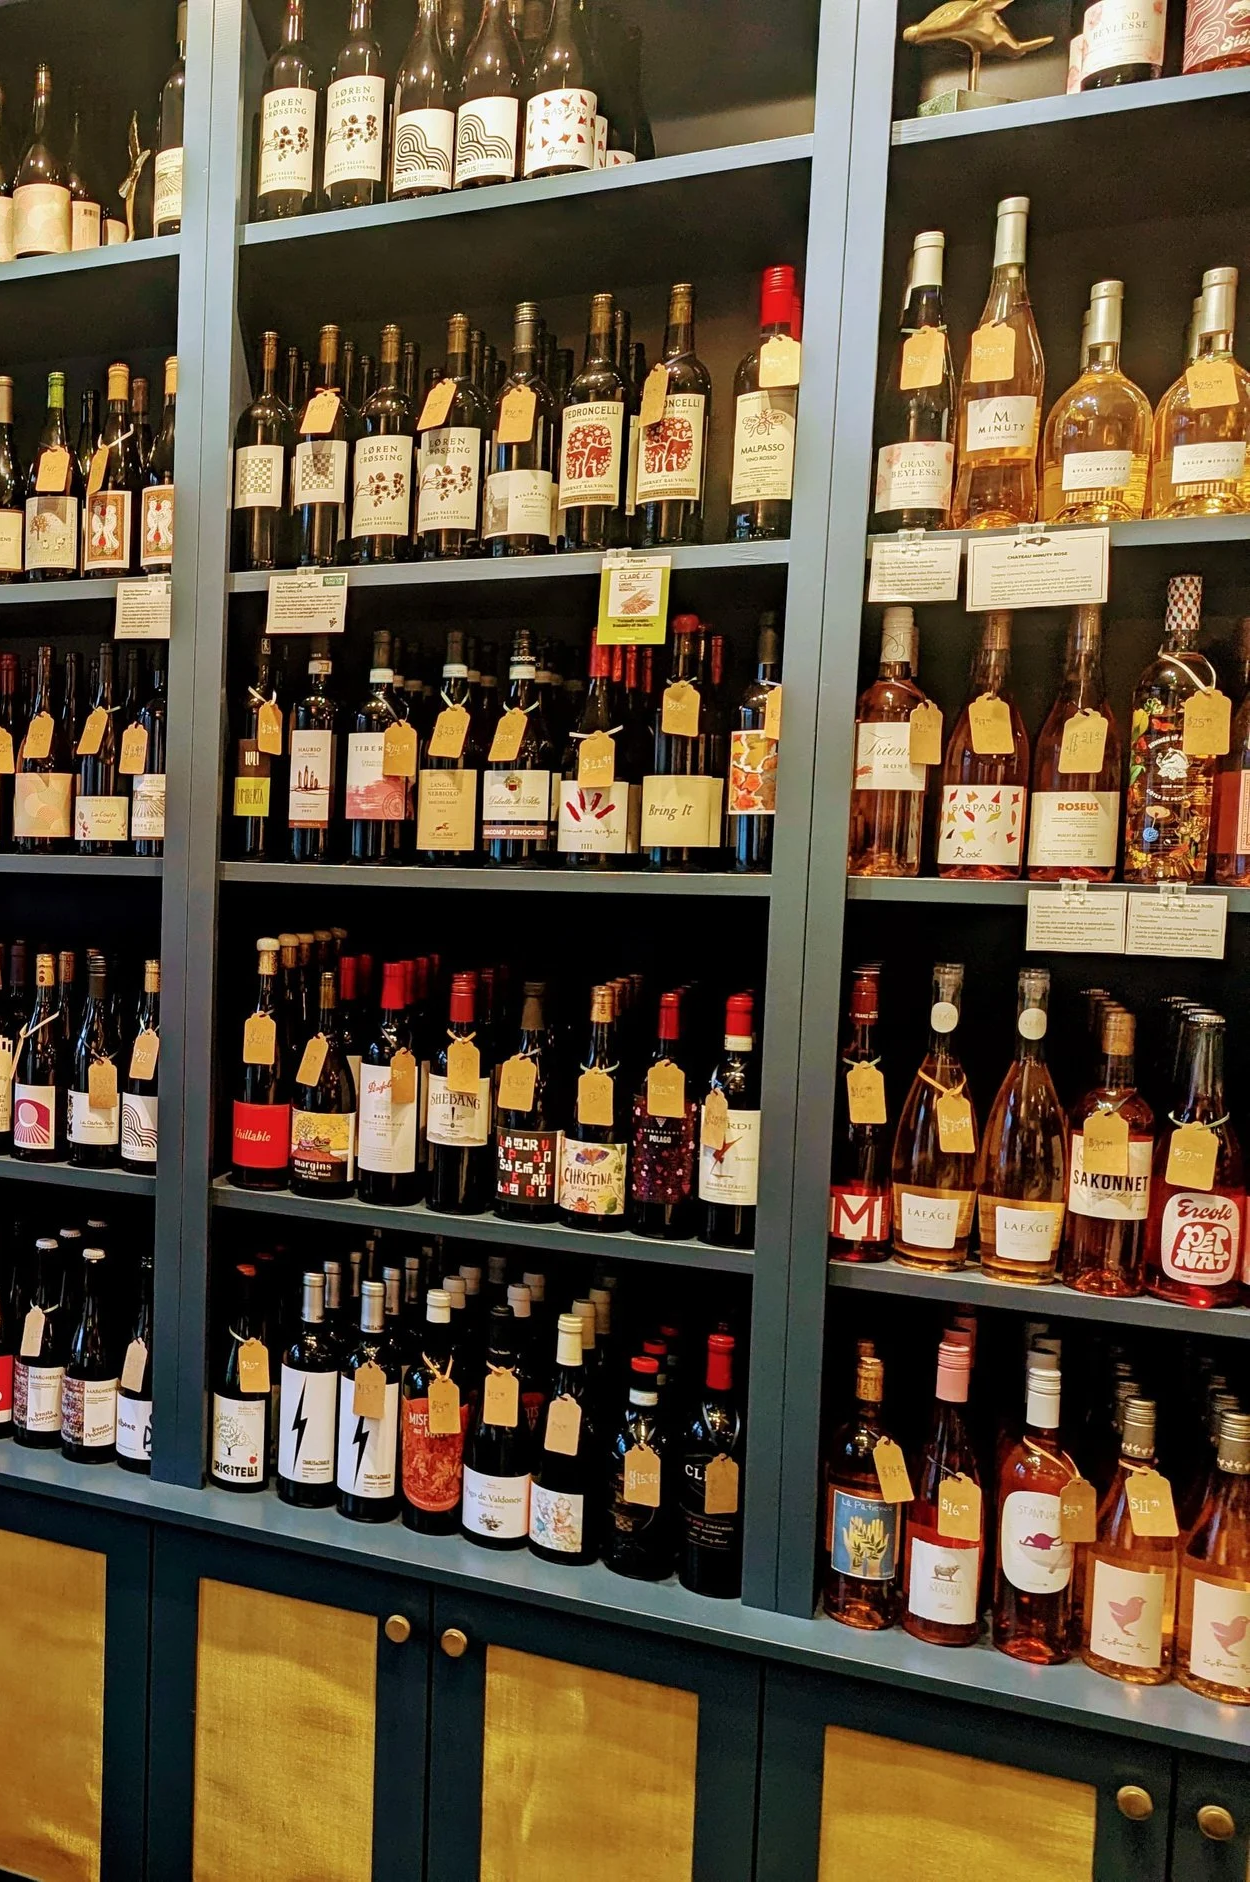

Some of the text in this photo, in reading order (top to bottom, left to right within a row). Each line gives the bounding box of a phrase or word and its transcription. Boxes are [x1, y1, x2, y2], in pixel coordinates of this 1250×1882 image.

[663, 399, 700, 409] ONCELLI
[565, 405, 619, 419] PEDRONCELLI
[978, 423, 1025, 434] MINUTY
[363, 445, 398, 455] LØREN
[740, 443, 785, 455] MALPASSO
[359, 454, 403, 464] CRØSSING
[900, 460, 935, 469] GRAND
[891, 469, 942, 478] BEYLESSE
[951, 803, 1001, 813] GASPARD
[1057, 802, 1100, 811] ROSEUS
[648, 804, 694, 821] Bring It
[953, 846, 983, 858] Rosé
[430, 1092, 481, 1110] SHEBANG
[727, 1122, 752, 1131] RDI
[648, 1134, 672, 1143] POLAGO
[294, 1159, 332, 1171] margins
[563, 1167, 613, 1186] CHRISTINA
[1073, 1169, 1149, 1192] SAKONNET
[1177, 1198, 1234, 1221] Ercole
[1173, 1249, 1230, 1270] NAT
[408, 1411, 429, 1426] MISF
[478, 1493, 487, 1501] de
